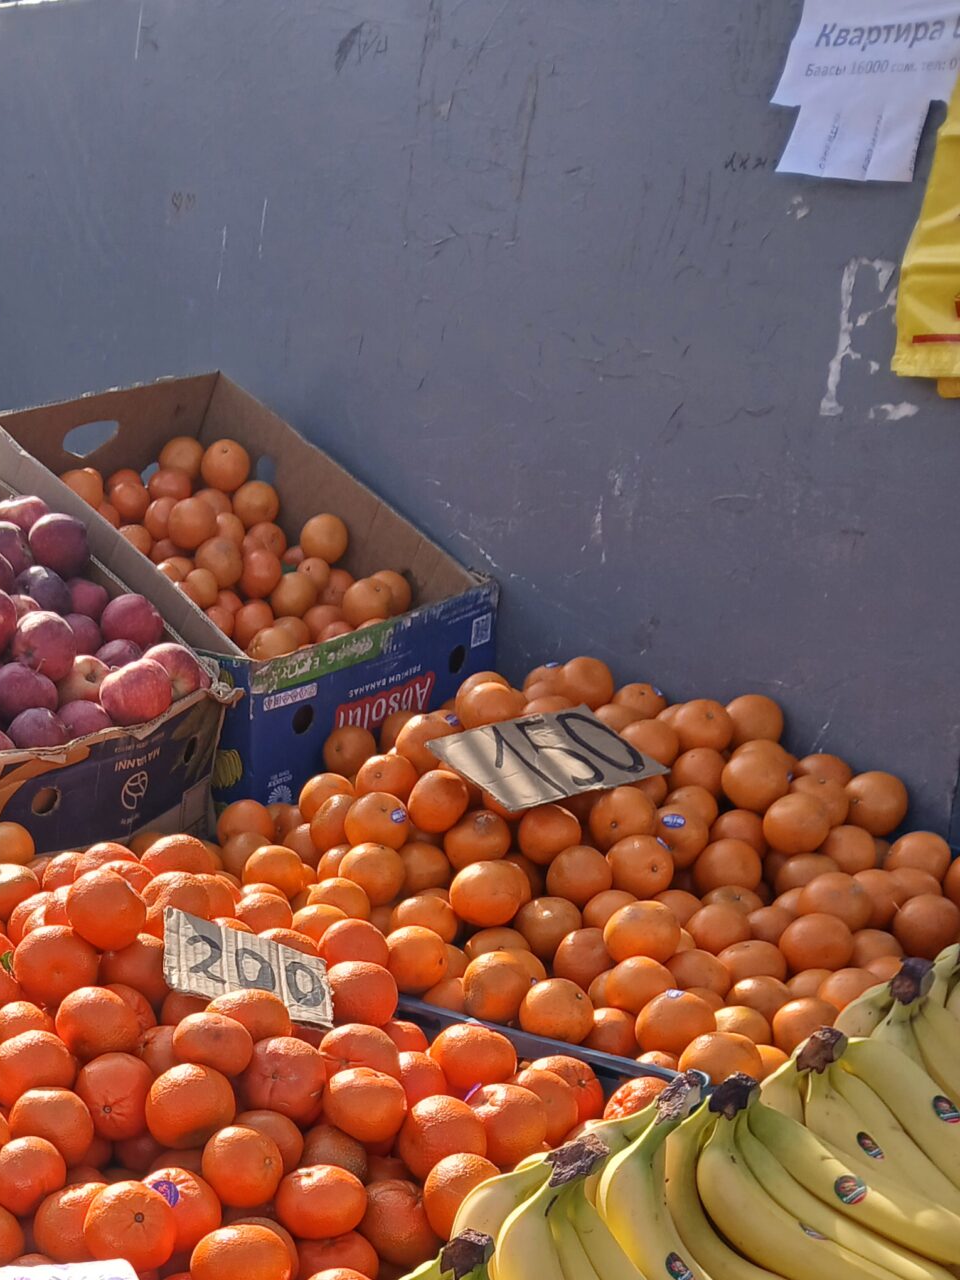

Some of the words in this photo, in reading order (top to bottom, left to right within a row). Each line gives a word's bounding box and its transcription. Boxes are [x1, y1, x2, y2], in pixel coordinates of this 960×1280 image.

[814, 19, 946, 51] Квартира
[850, 59, 889, 75] 16000
[492, 712, 645, 797] 150
[185, 934, 326, 1008] 200
